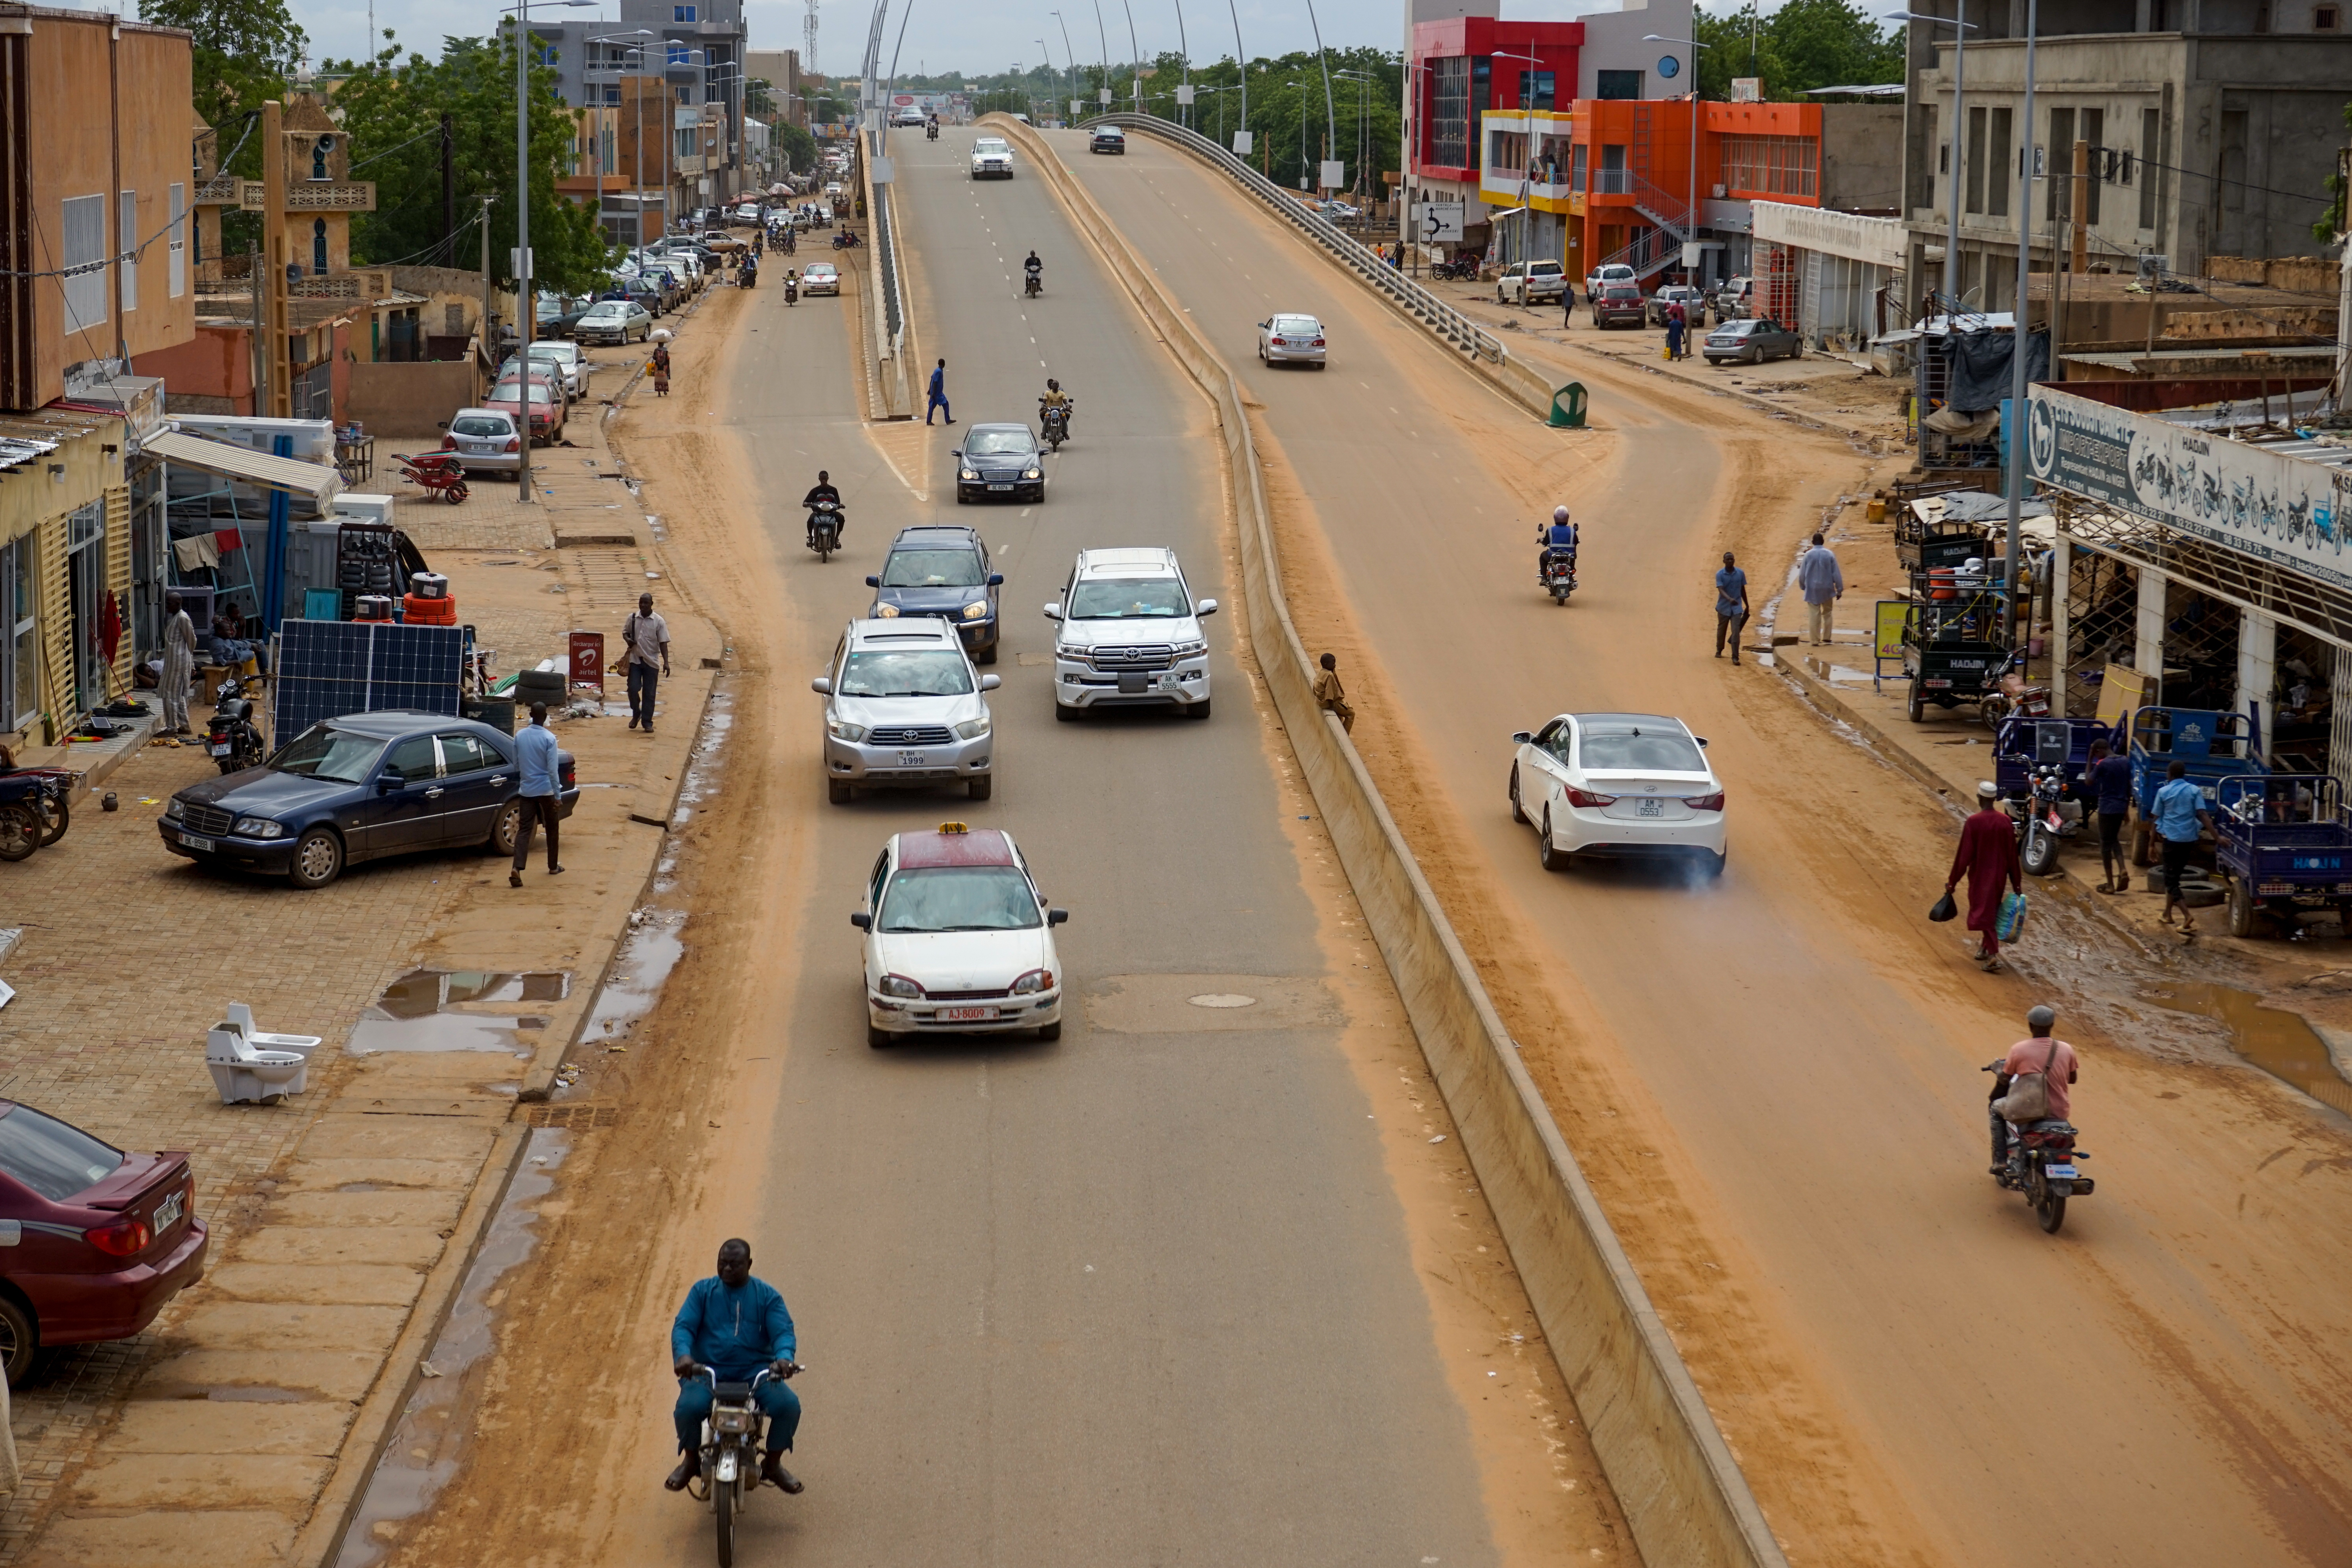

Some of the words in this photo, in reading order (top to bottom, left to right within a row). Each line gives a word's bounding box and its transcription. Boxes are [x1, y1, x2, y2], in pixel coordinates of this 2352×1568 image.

[2088, 486, 2110, 501] NIAMEY
[2270, 550, 2291, 567] Email
[1641, 808, 1659, 816] 0553
